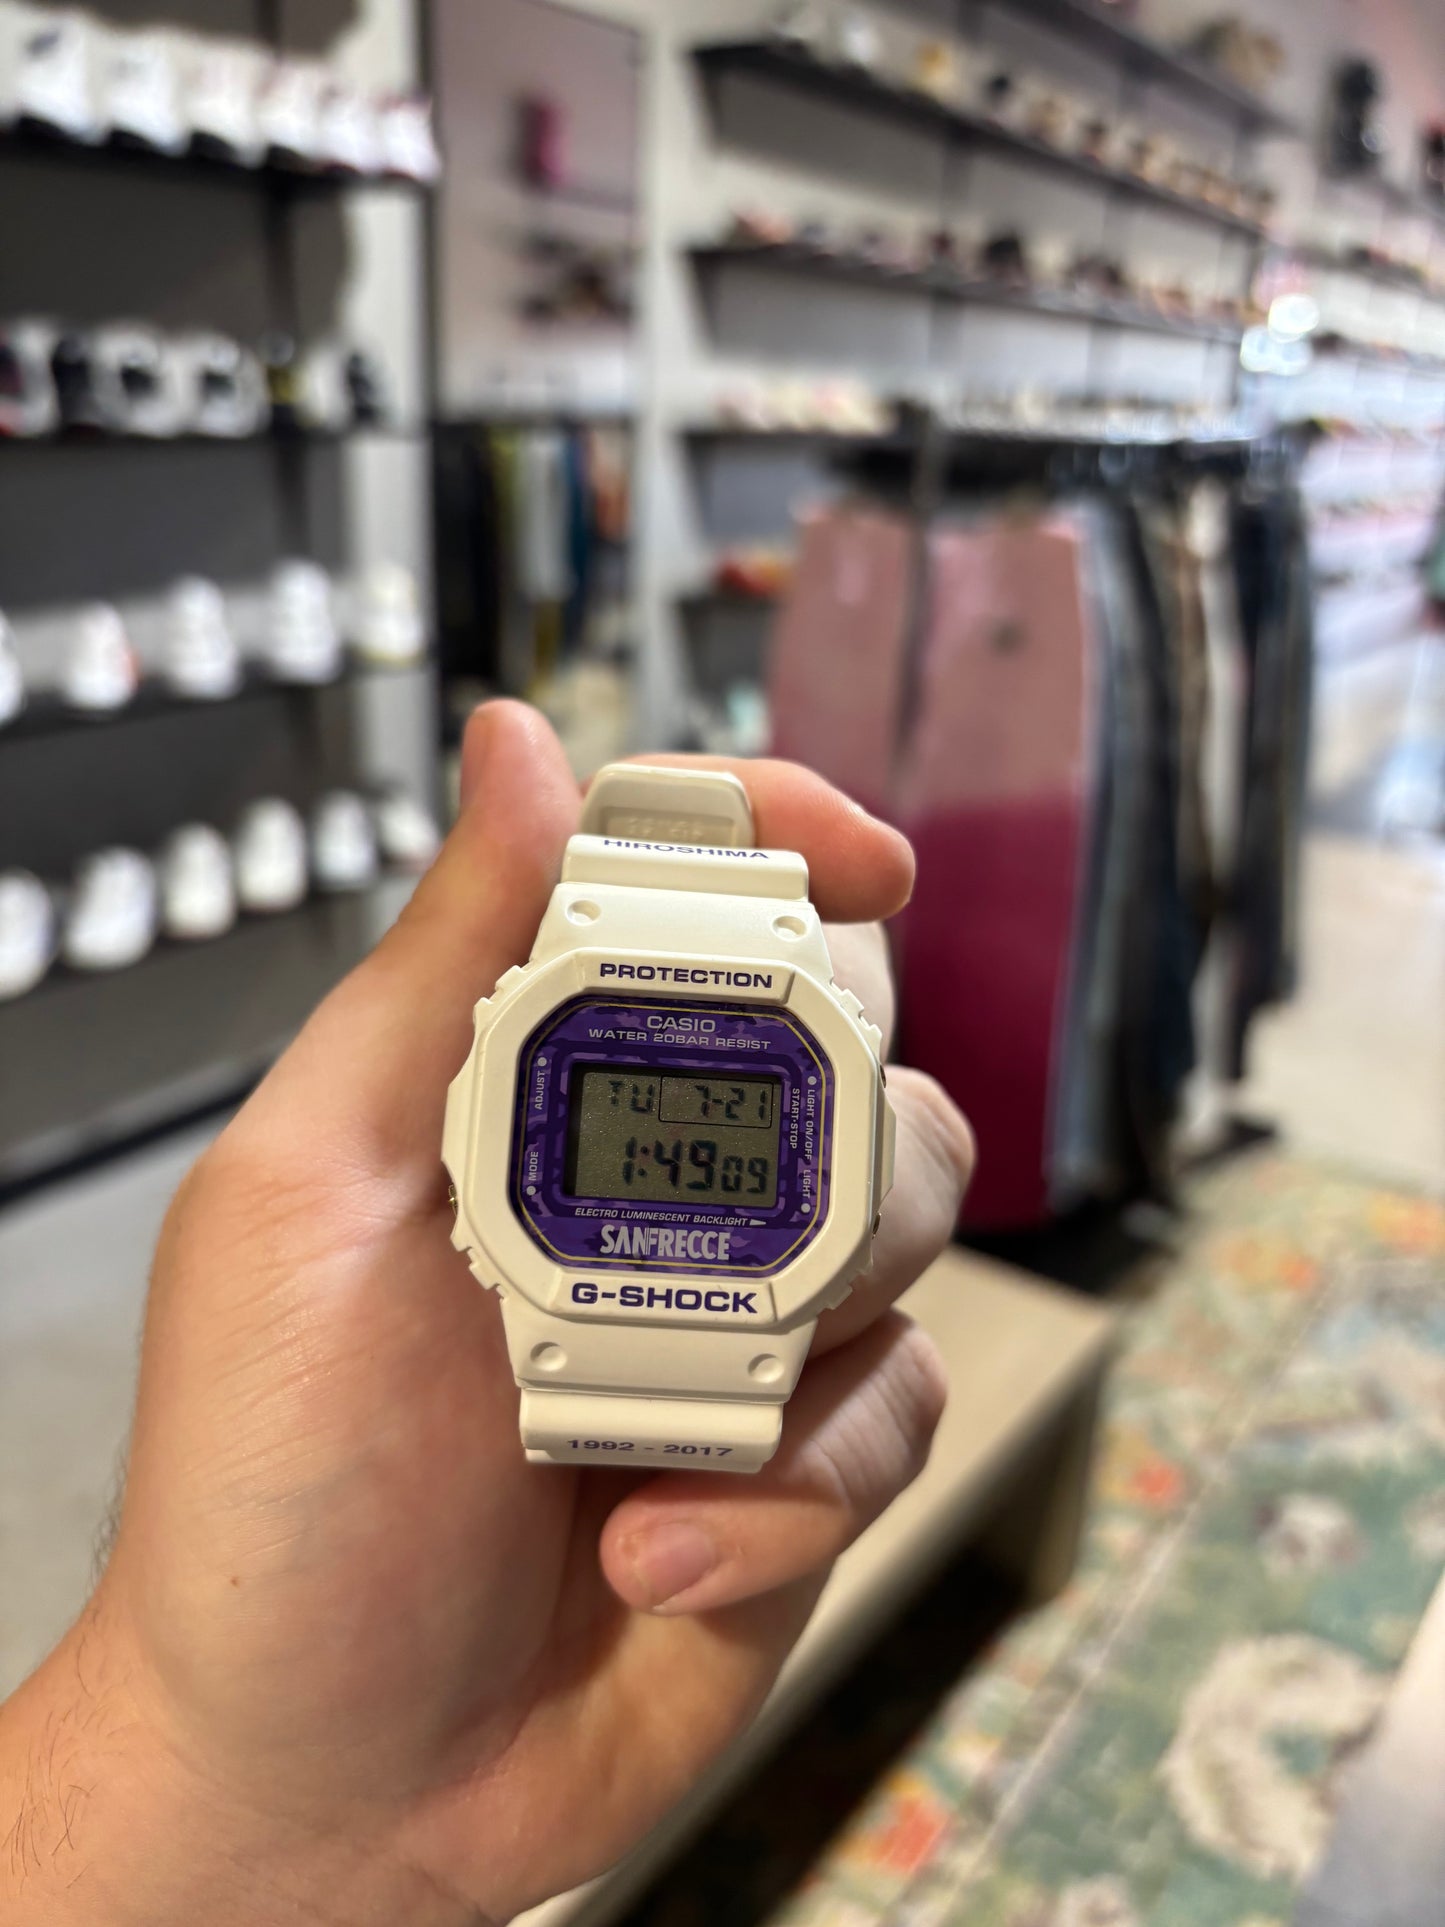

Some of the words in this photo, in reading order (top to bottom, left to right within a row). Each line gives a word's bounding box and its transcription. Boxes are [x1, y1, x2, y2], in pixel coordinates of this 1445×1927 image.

[603, 838, 769, 859] HIROSHIMA
[599, 962, 773, 989] PROTECTION
[588, 1028, 648, 1042] WATER
[653, 1034, 710, 1047] 20BAR
[715, 1038, 772, 1050] RESIST
[646, 1015, 716, 1033] CASIO
[534, 1070, 546, 1110] ADJUST
[609, 1080, 656, 1114] TU
[694, 1084, 767, 1121] 7-21
[805, 1089, 816, 1118] LIGHT
[804, 1120, 814, 1161] ON/OFF
[528, 1151, 540, 1181] MODE
[622, 1136, 717, 1192] 1:49
[802, 1169, 812, 1199] LIGHT
[574, 1207, 618, 1219] ELECTRO
[620, 1210, 690, 1223] LUMINESCENT
[693, 1215, 749, 1228] BACKLIGHT
[600, 1224, 732, 1260] SANFRECCE
[571, 1282, 758, 1314] G-SHOCK
[567, 1439, 635, 1451] 1992
[663, 1444, 734, 1457] 2017
